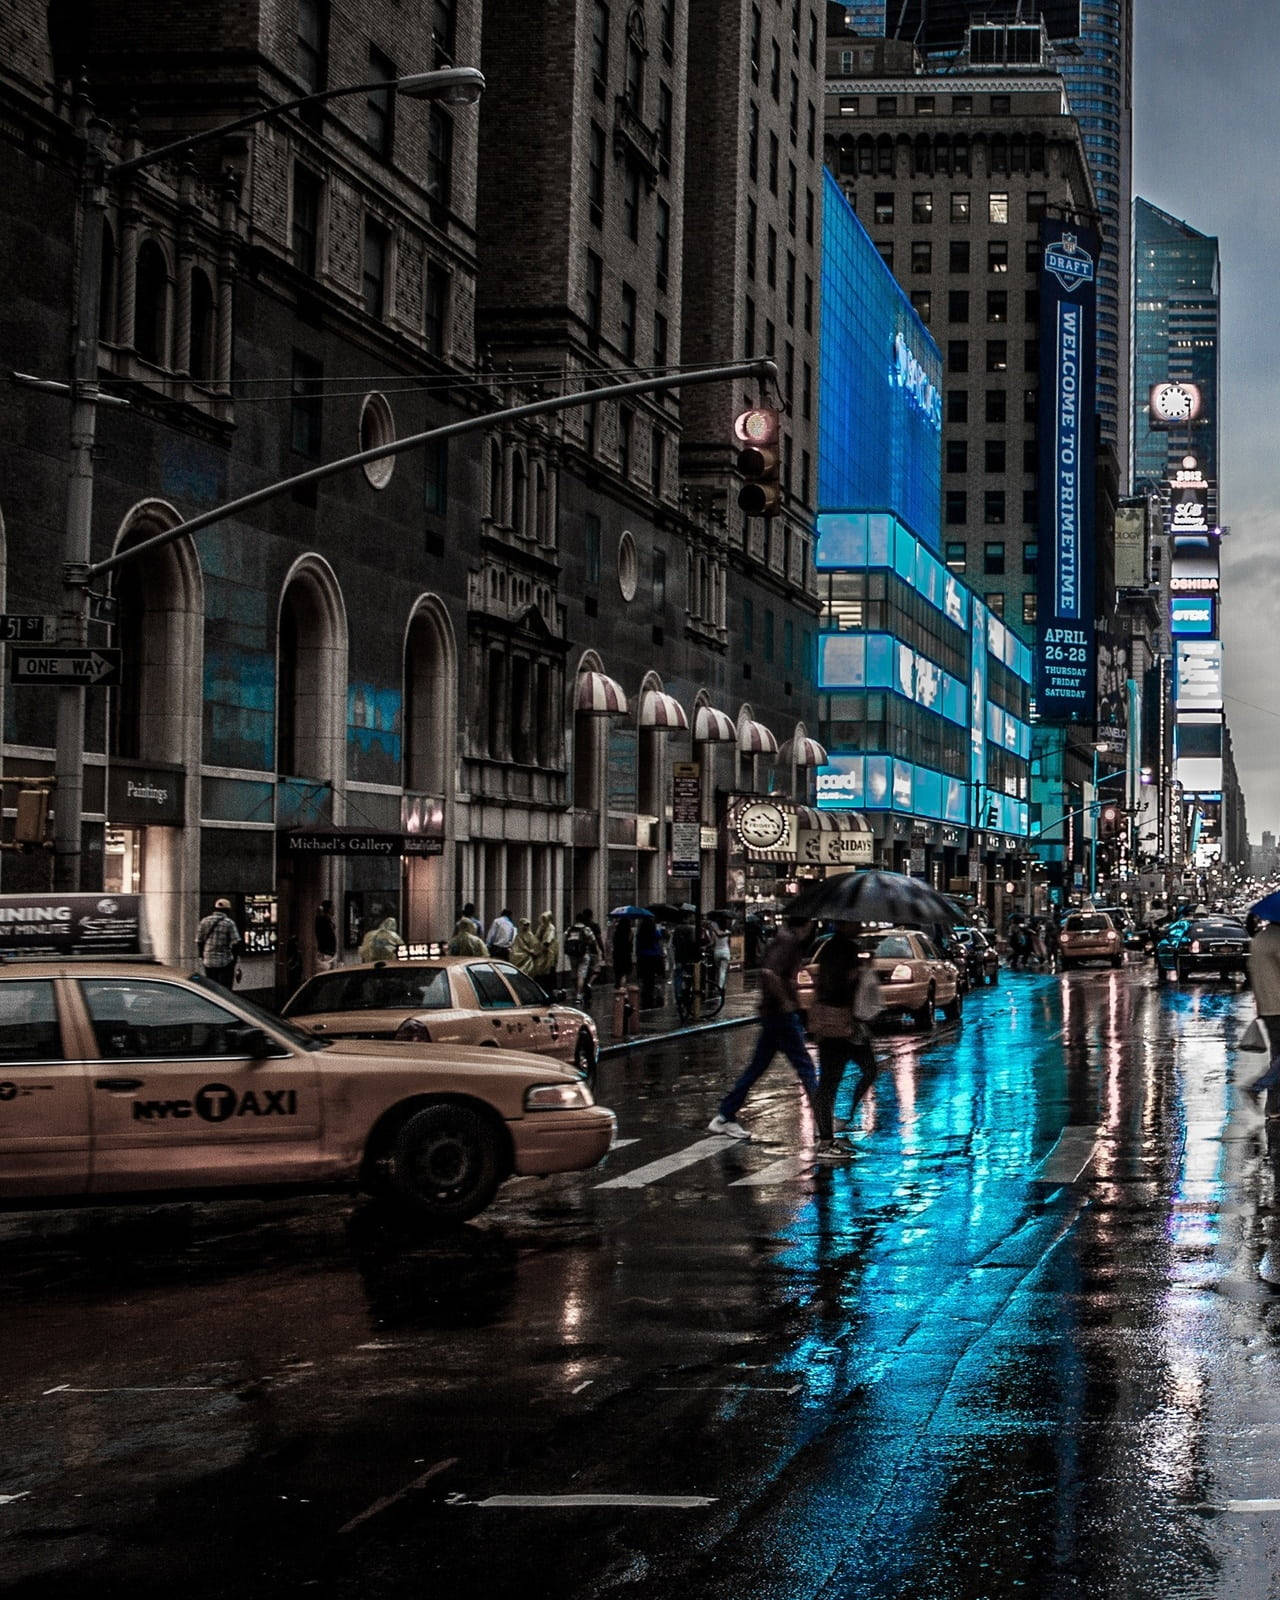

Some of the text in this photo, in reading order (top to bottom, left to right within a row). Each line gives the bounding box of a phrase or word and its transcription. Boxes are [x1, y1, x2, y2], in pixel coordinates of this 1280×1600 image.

[1049, 255, 1089, 274] DRAFT
[1061, 311, 1076, 610] WELCOME TO PRIMETIME
[1170, 579, 1218, 589] OSHIBA
[6, 617, 40, 638] 51 ST
[1044, 628, 1087, 645] APRIL
[1045, 646, 1087, 662] 26-28
[27, 659, 105, 674] ONE WAY
[1045, 666, 1087, 676] THURSDAY
[1051, 677, 1080, 687] FRIDAY
[1045, 688, 1086, 698] SATURDAY
[127, 780, 168, 804] Paintings
[289, 838, 394, 852] Michael's Gallery
[134, 1083, 297, 1122] NYC TAXI
